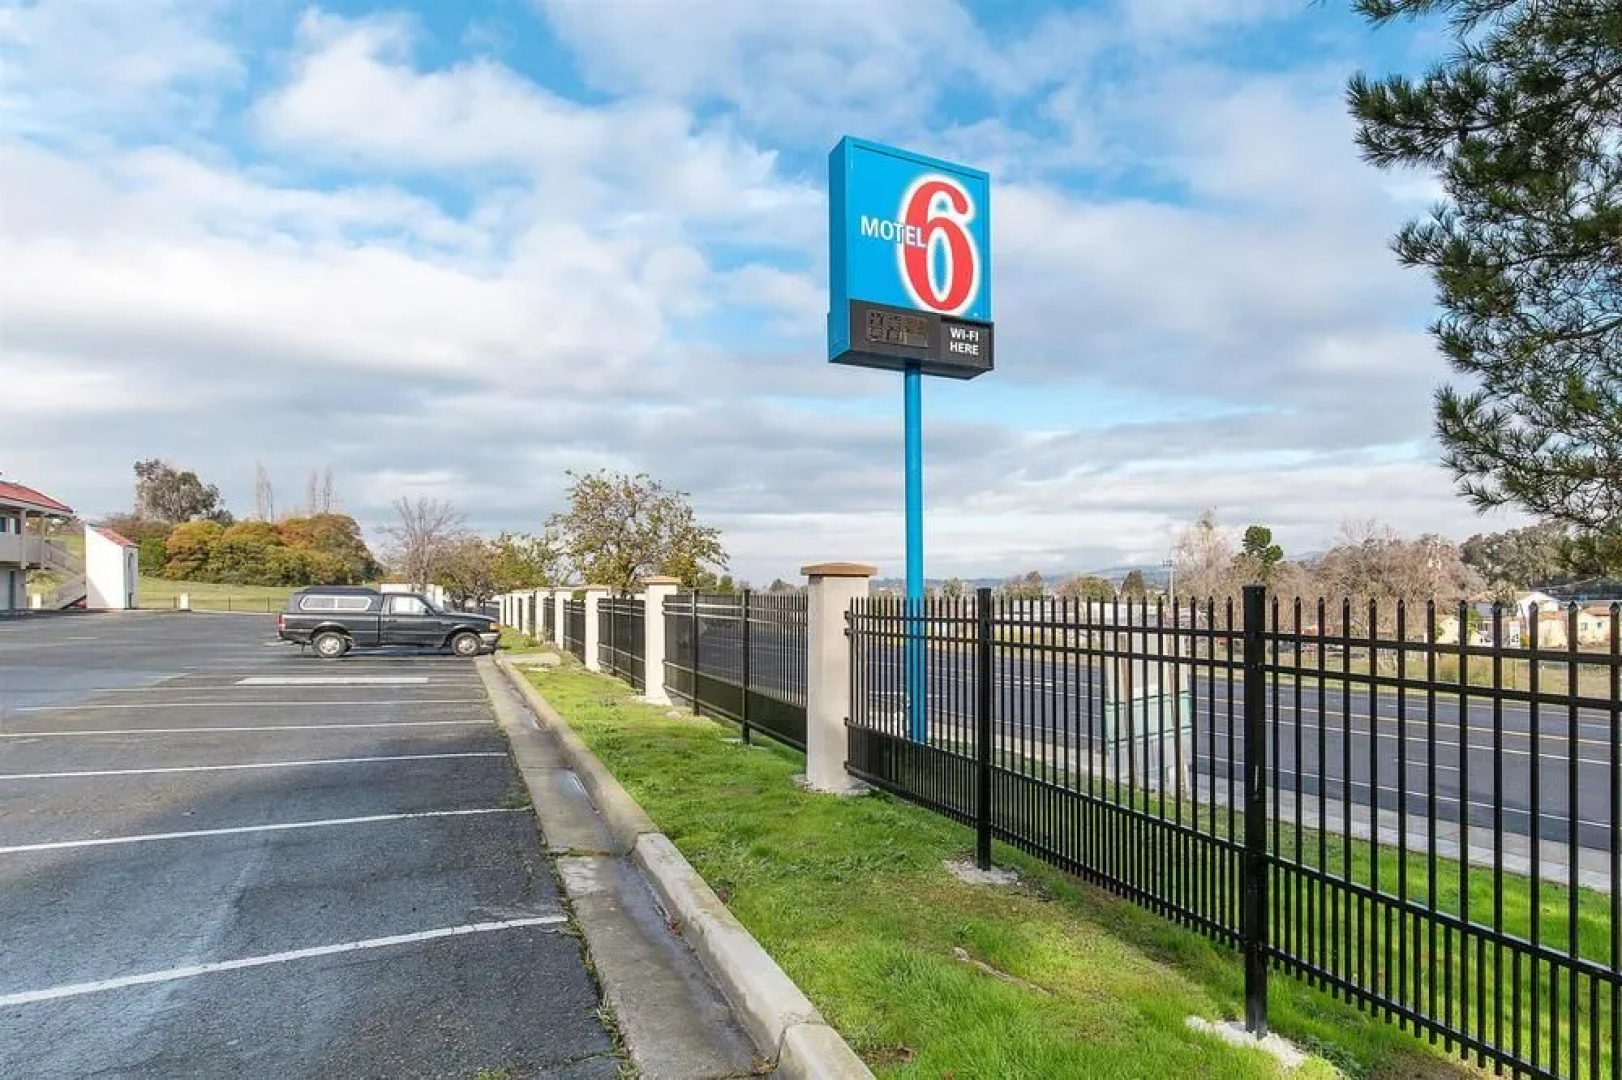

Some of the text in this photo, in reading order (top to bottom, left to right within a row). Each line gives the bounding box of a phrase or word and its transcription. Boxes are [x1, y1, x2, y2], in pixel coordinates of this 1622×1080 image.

[861, 178, 976, 313] MOTEL 6
[950, 341, 979, 355] HERE
